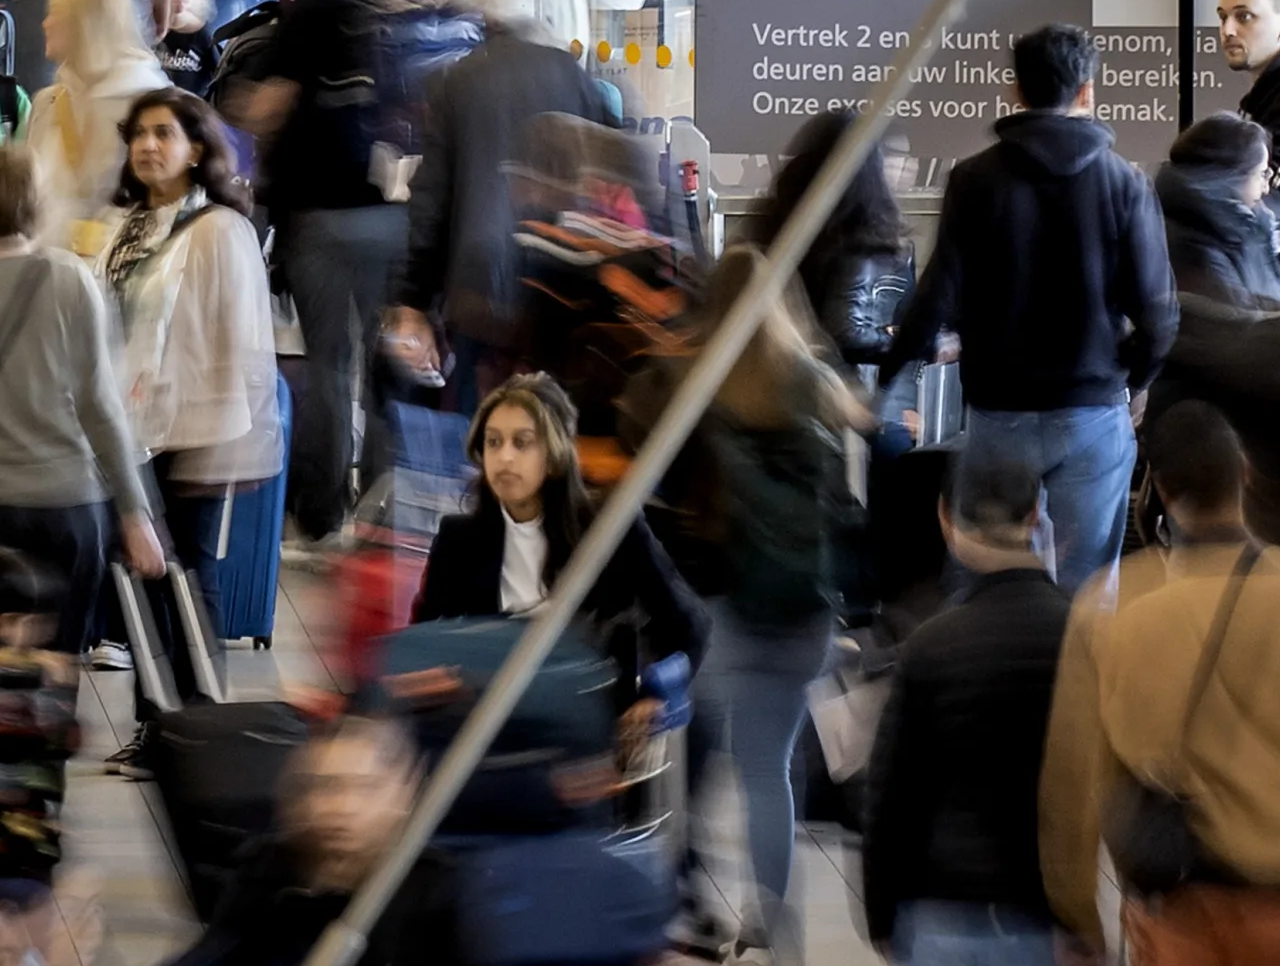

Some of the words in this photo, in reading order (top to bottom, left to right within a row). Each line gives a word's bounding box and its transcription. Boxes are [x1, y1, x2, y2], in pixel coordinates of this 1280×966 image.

[752, 23, 849, 48] Vertrek
[856, 25, 871, 48] 2
[878, 31, 911, 49] en
[941, 26, 1000, 51] kunt
[1195, 31, 1218, 54] ia
[752, 56, 844, 83] deuren
[907, 66, 947, 84] uw
[752, 91, 819, 115] Onze
[929, 100, 988, 119] voor
